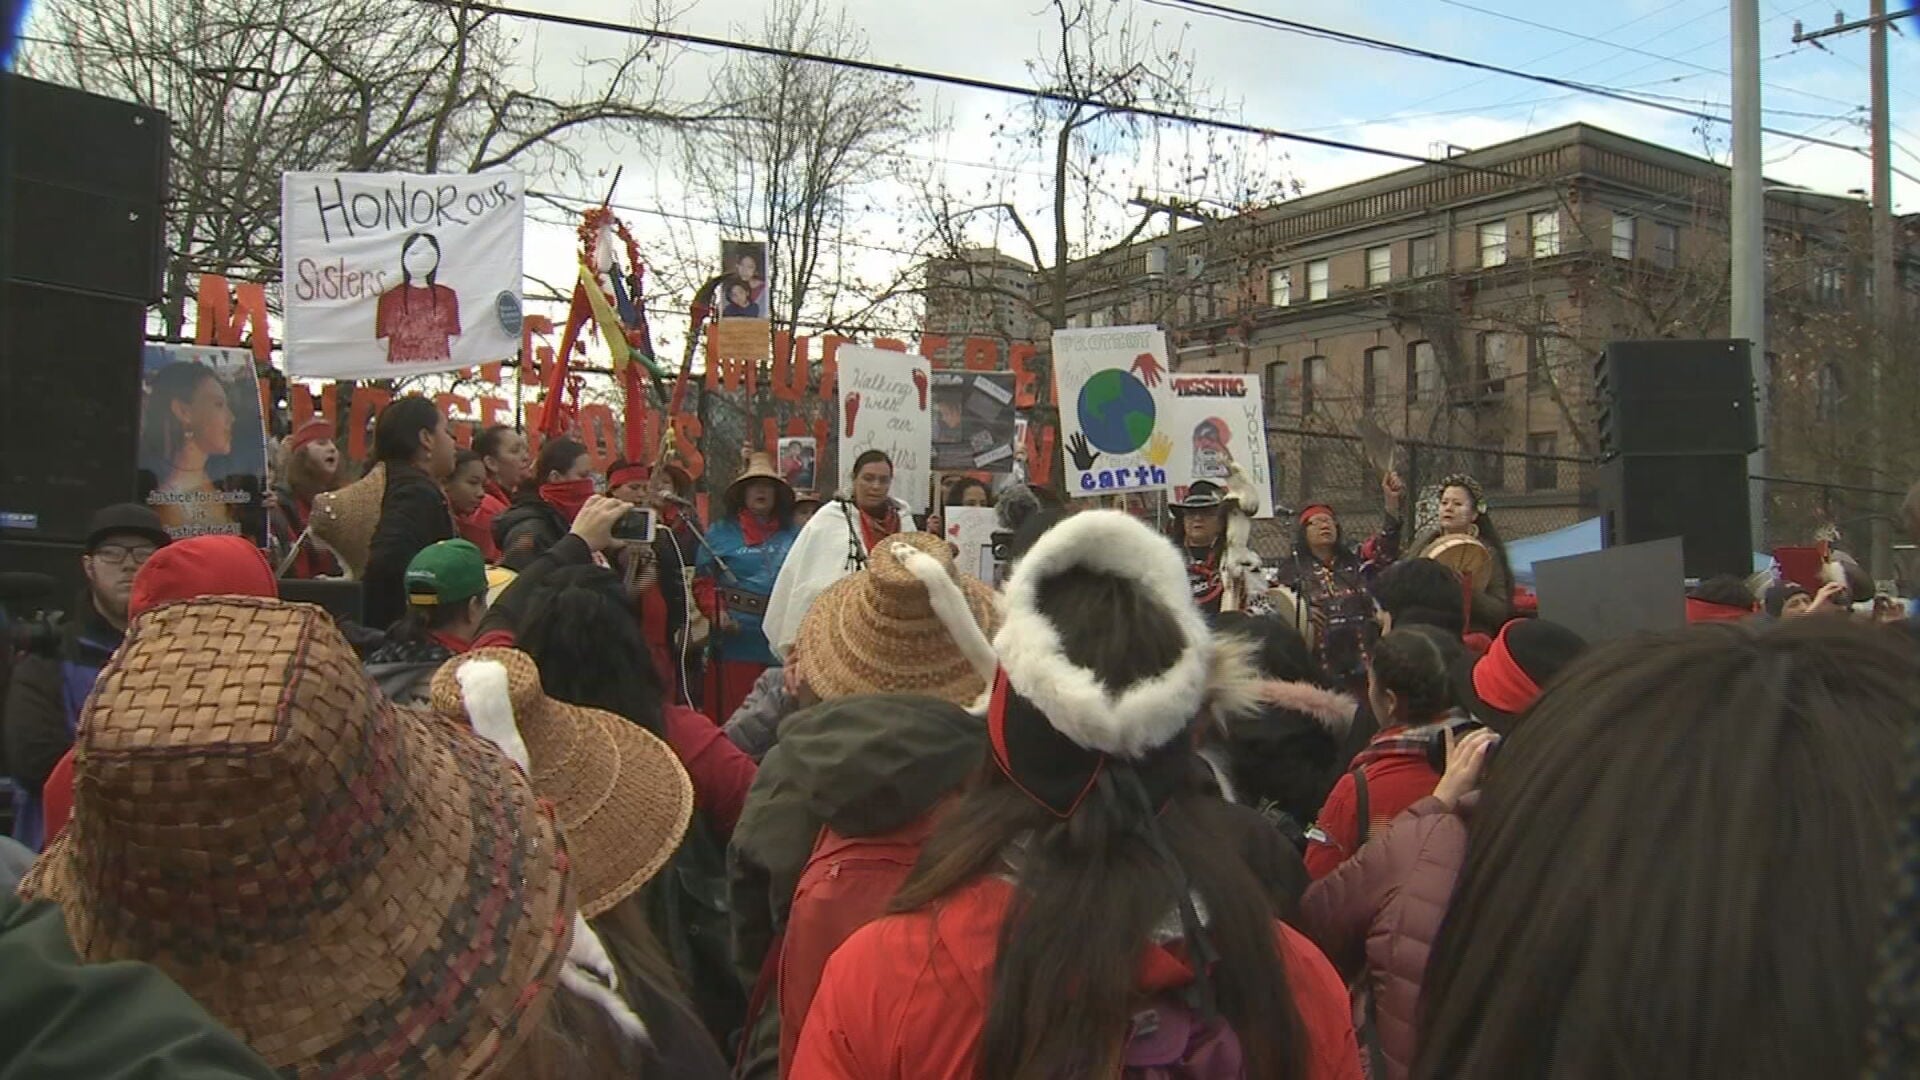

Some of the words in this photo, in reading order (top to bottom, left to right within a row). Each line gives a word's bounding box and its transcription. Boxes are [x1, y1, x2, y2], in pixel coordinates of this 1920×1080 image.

[315, 178, 468, 243] HONOR
[465, 180, 516, 217] OUR
[295, 257, 387, 301] Sisters
[853, 367, 913, 402] Walking
[1170, 376, 1248, 398] MISSING
[863, 395, 901, 413] with
[1242, 403, 1265, 485] WOMEN
[1080, 464, 1166, 490] earth
[147, 489, 192, 504] Justice
[193, 490, 210, 503] for
